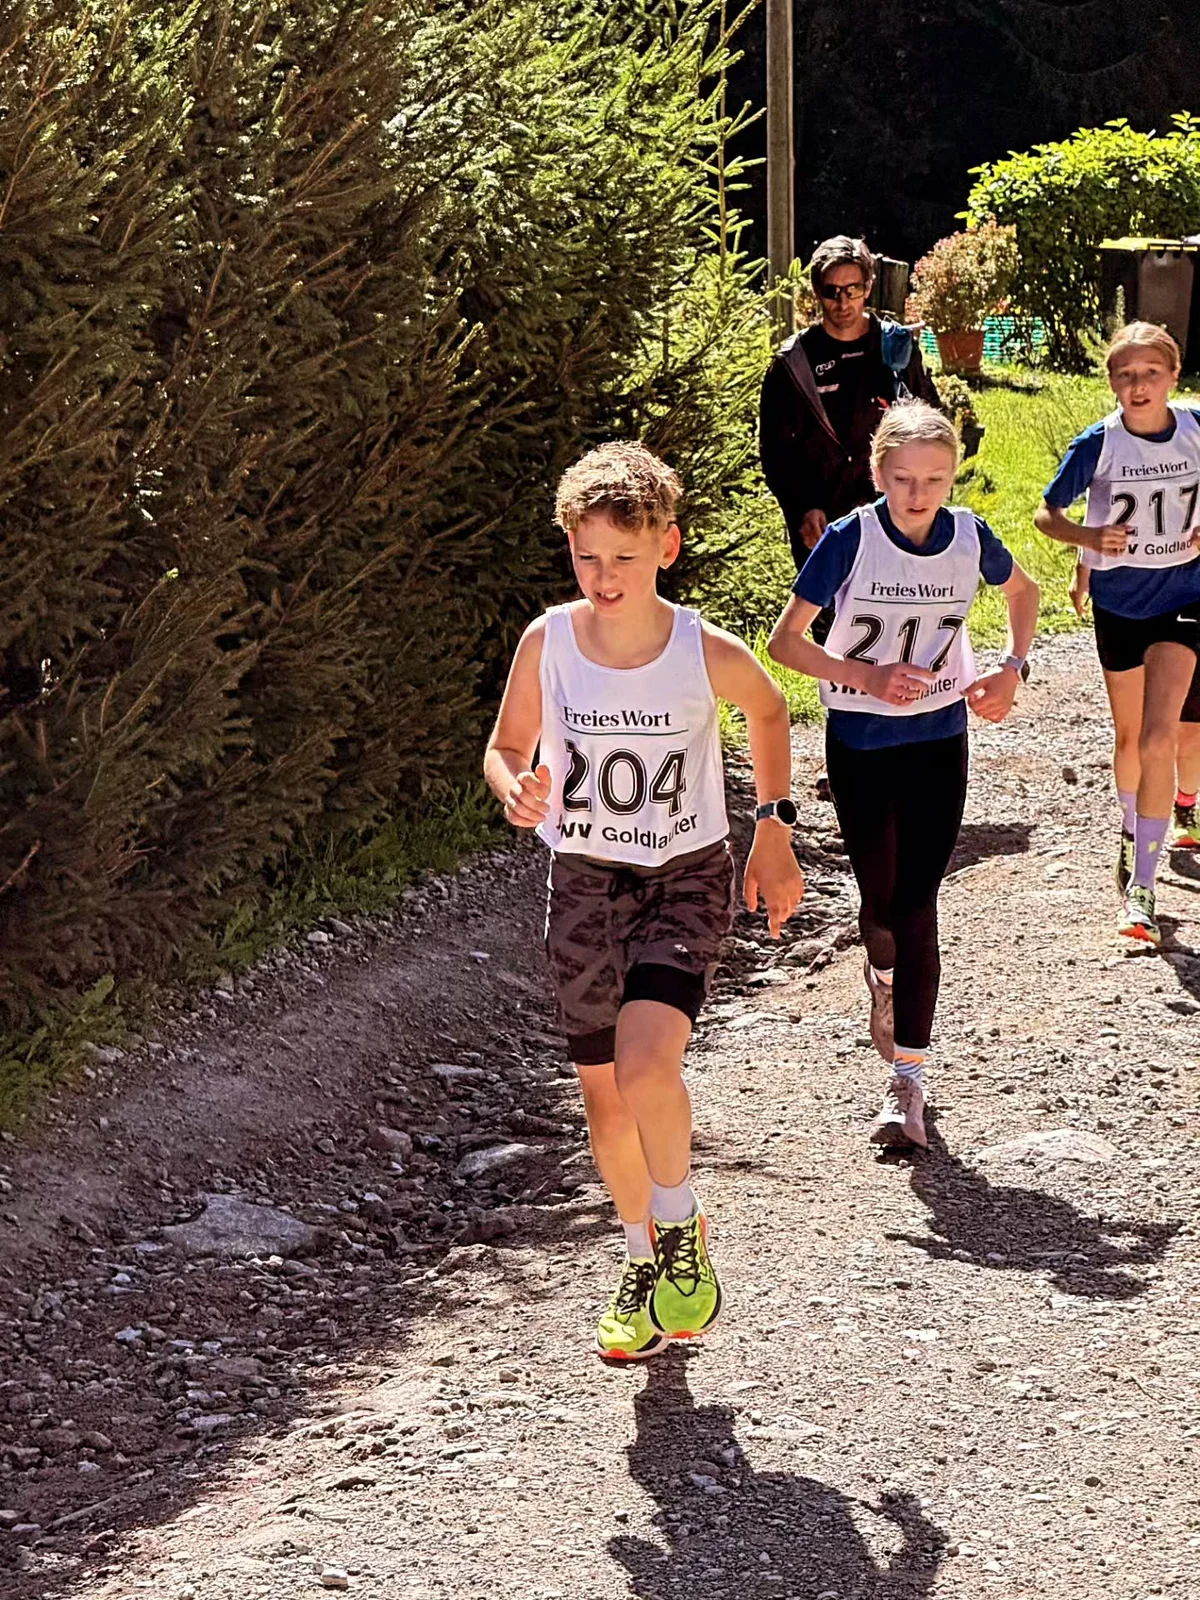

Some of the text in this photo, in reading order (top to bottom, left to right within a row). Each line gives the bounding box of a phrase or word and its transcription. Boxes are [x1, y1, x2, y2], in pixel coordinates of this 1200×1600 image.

[1122, 461, 1188, 477] Freies Wort
[1111, 483, 1199, 537] 217
[870, 581, 954, 598] Freies Wort
[563, 706, 672, 727] Freies Wort
[563, 738, 688, 818] 204
